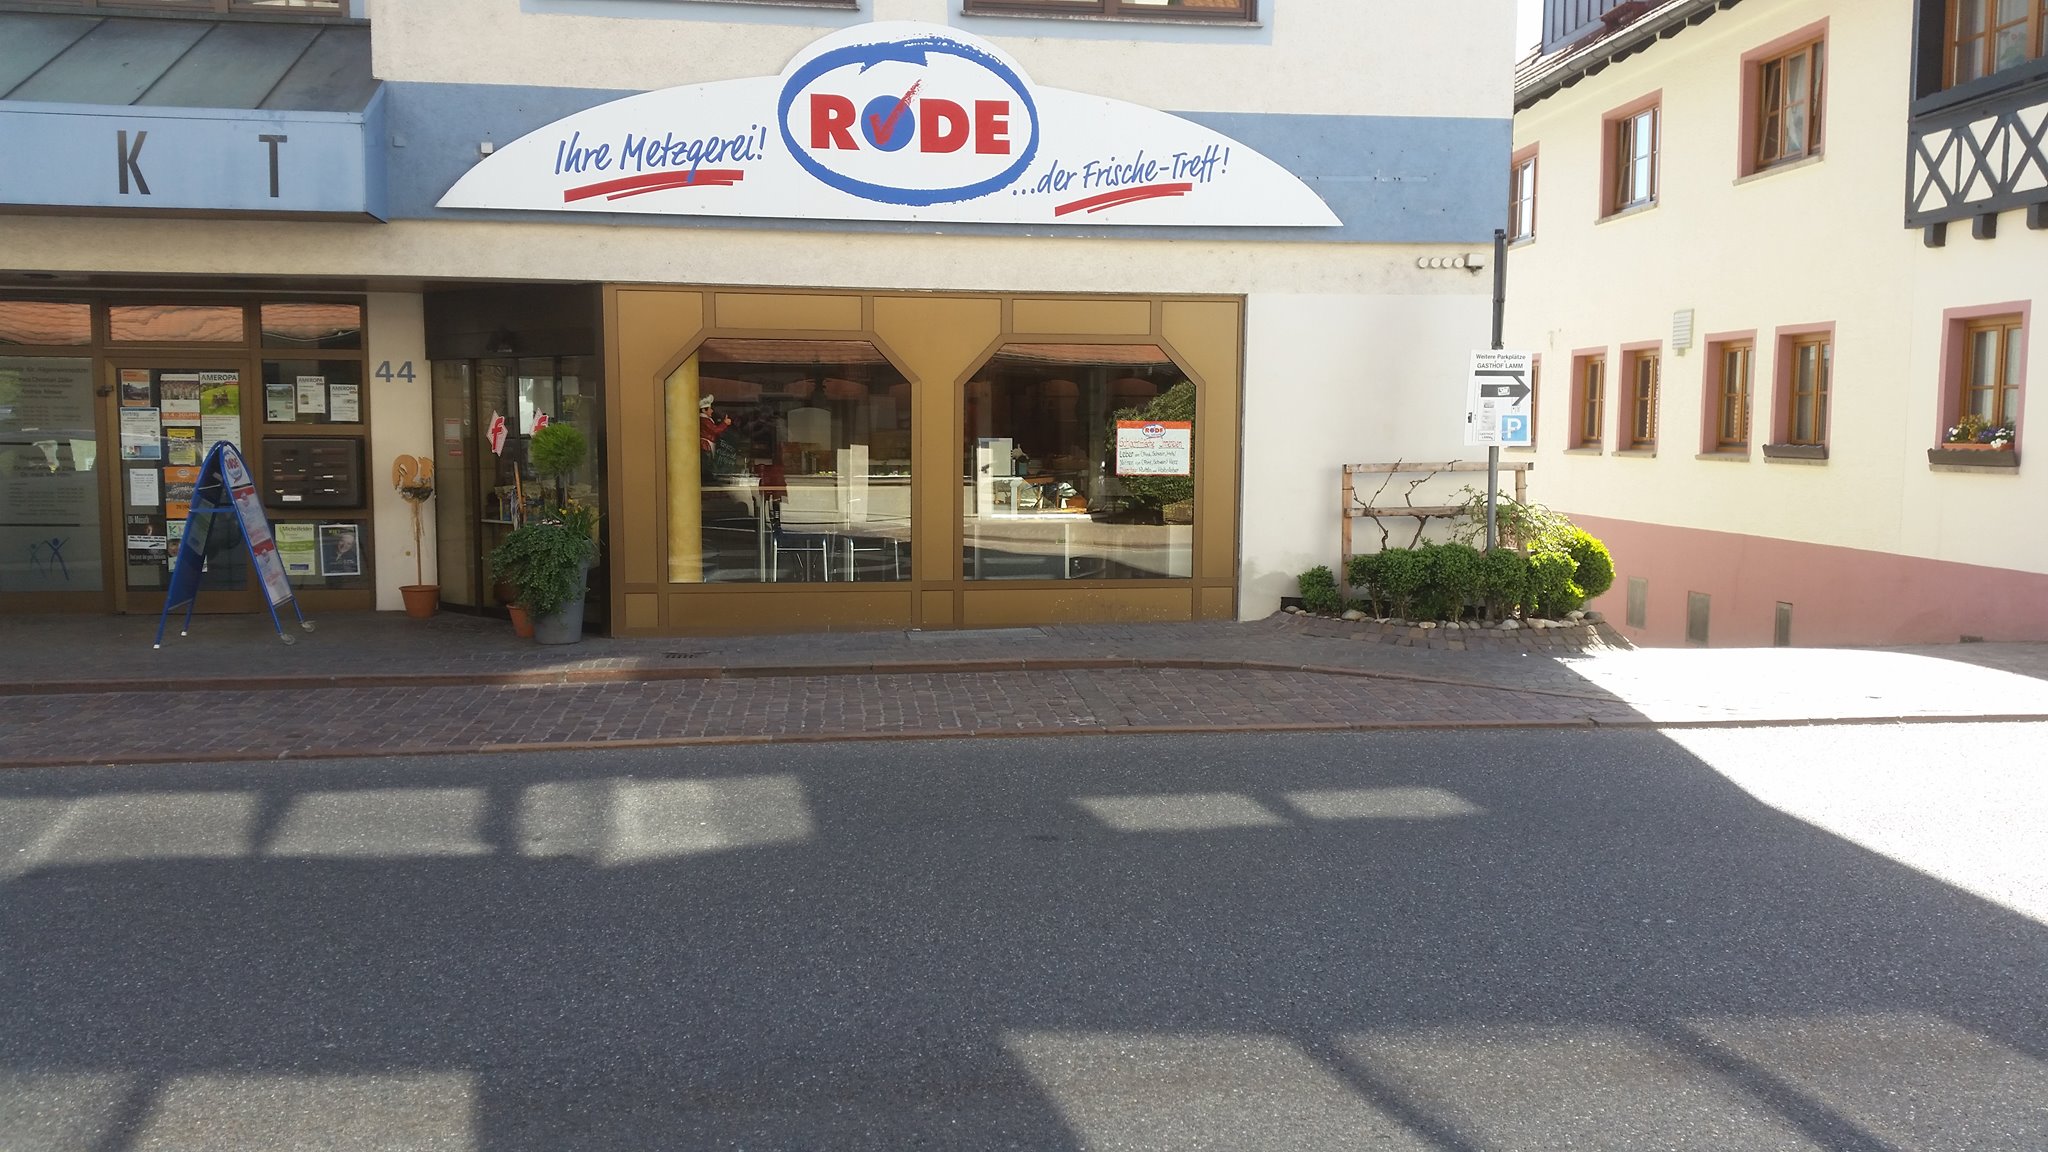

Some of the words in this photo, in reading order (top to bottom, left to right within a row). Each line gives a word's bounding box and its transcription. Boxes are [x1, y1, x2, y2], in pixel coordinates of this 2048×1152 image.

[554, 130, 612, 175] Ihre
[619, 124, 767, 184] Metzgerei!
[1082, 144, 1231, 189] Frische-Treff!
[1497, 353, 1526, 361] Parkplätze
[375, 360, 417, 383] 44
[1507, 418, 1522, 439] P
